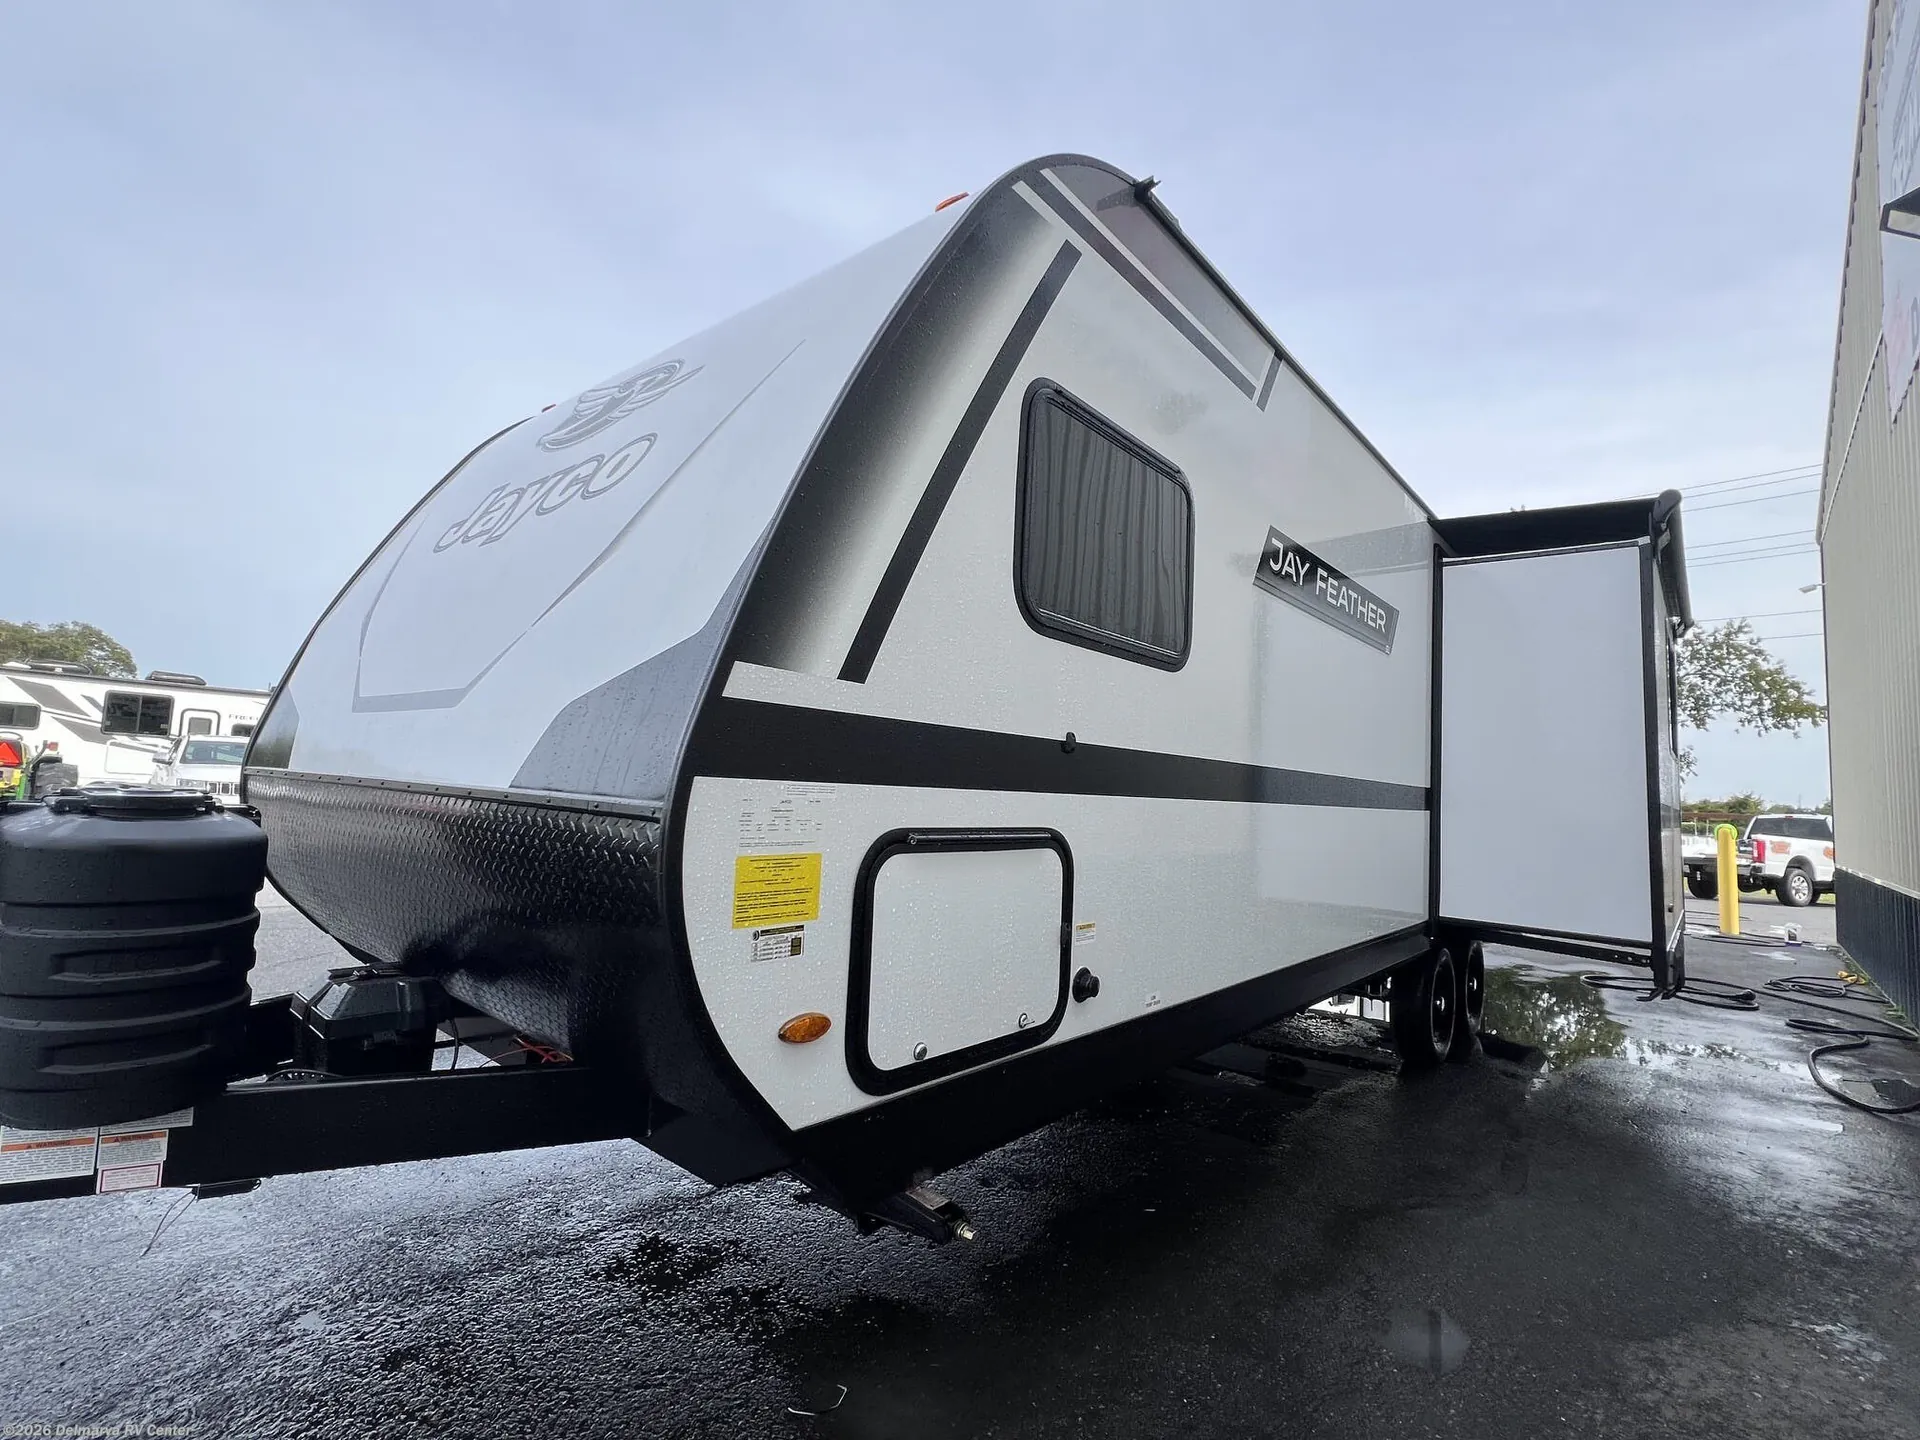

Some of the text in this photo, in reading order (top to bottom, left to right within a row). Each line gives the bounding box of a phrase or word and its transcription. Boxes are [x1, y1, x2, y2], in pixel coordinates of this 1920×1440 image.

[1269, 537, 1387, 633] JAY FEATHER
[35, 1140, 71, 1149] WARNING
